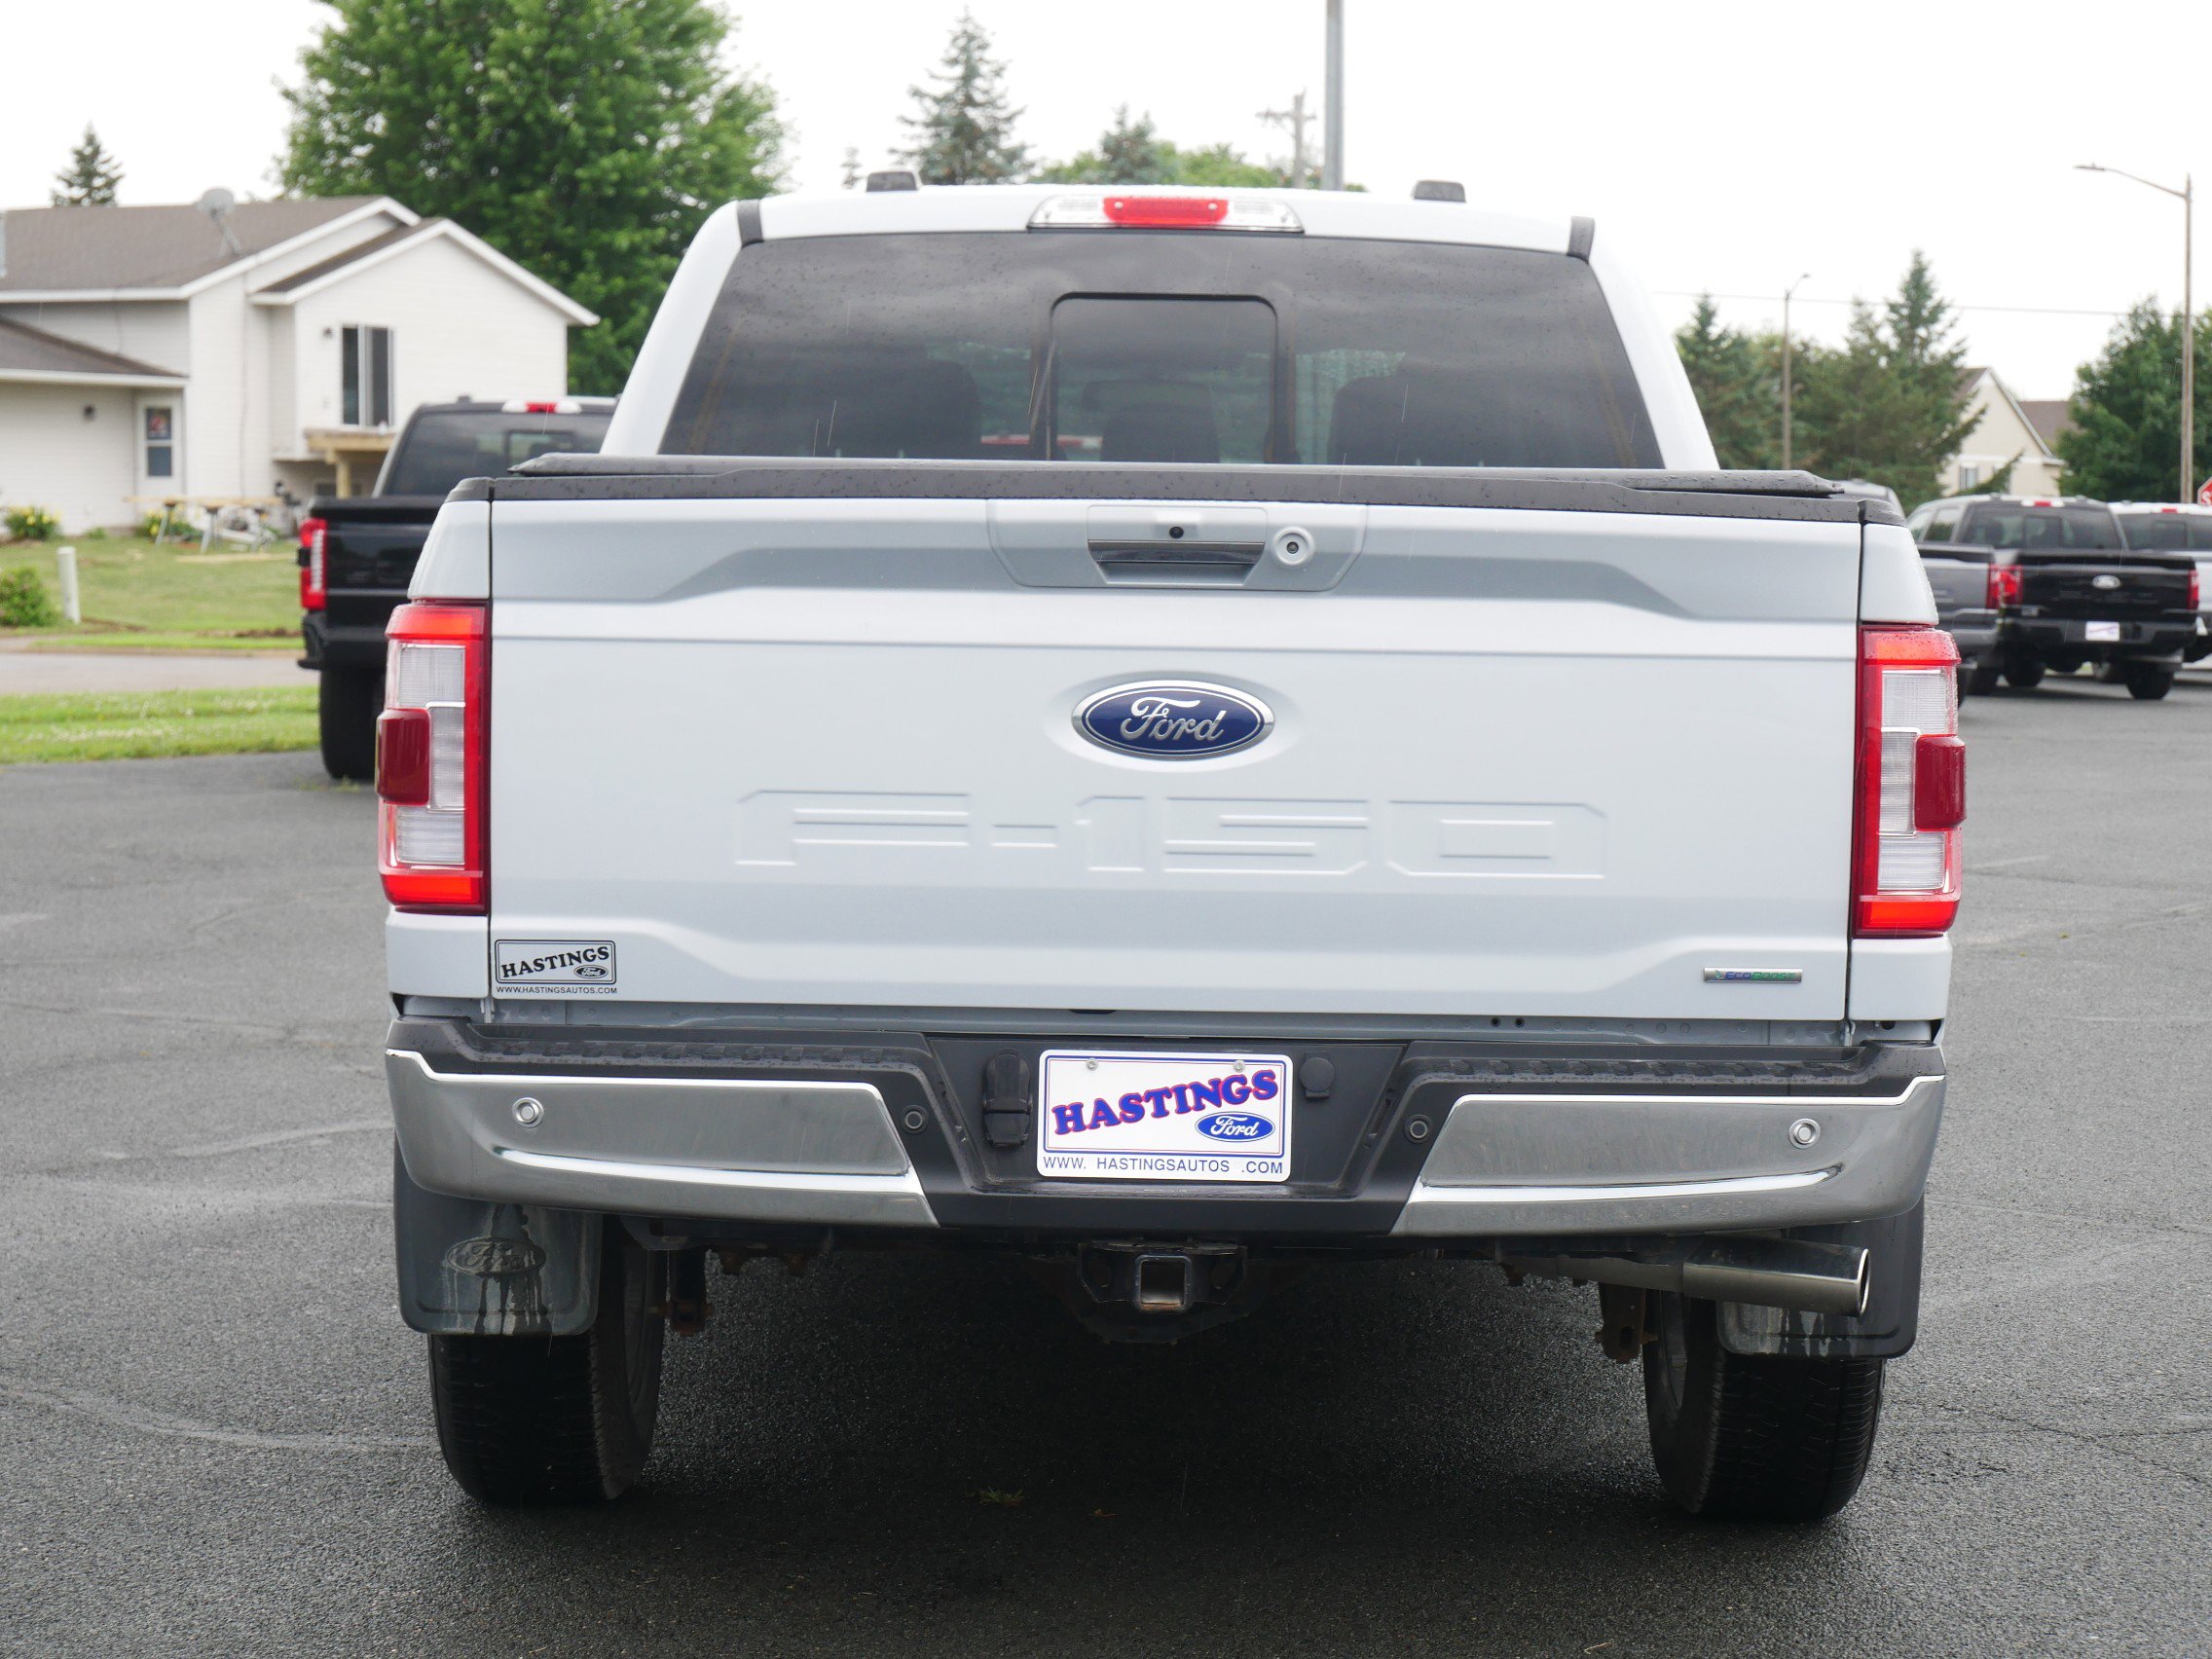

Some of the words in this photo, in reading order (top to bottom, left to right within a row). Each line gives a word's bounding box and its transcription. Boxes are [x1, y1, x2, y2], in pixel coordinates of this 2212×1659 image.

[1121, 696, 1227, 741] Ford
[734, 788, 1606, 879] F-150
[500, 945, 610, 977] HASTINGS
[496, 985, 617, 994] WWW.HASTINGSAUTOS.COM
[1051, 1069, 1278, 1135] HASTINGS
[1210, 1115, 1259, 1137] Ford
